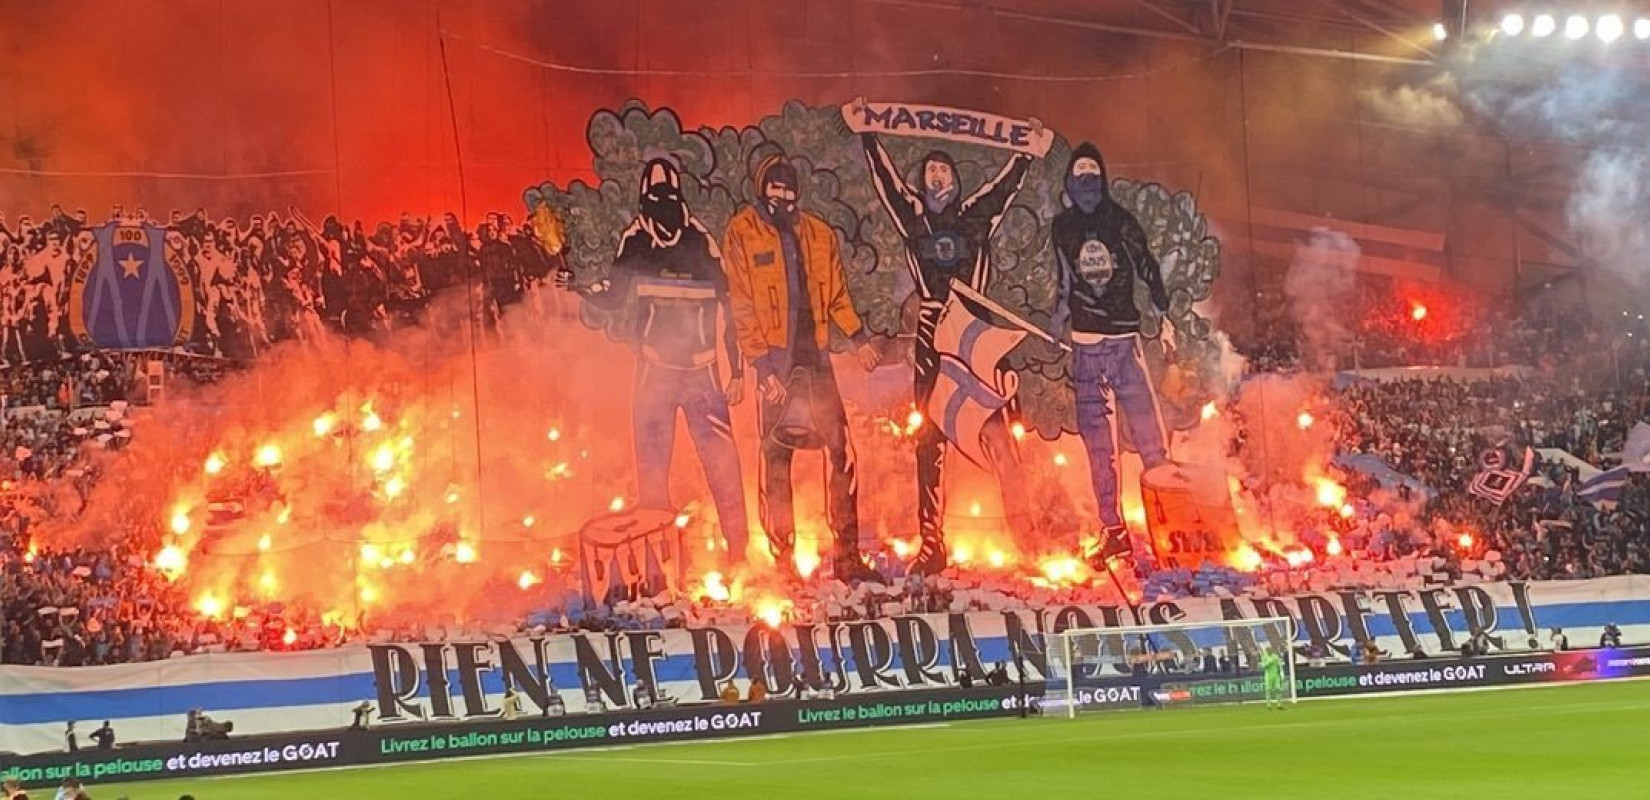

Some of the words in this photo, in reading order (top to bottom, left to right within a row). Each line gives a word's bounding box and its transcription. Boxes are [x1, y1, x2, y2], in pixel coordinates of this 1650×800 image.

[863, 106, 1033, 147] MARSEILLE
[119, 230, 142, 241] 100
[366, 634, 560, 722] RIEN
[570, 629, 680, 711] NE
[687, 610, 998, 701] POURRA
[998, 600, 1198, 682] NOUS
[1508, 581, 1539, 649] !
[1305, 673, 1357, 693] pelouse
[1359, 674, 1374, 687] et
[1375, 668, 1428, 685] devenez
[1429, 667, 1441, 681] le
[1442, 664, 1486, 681] GOAT
[798, 707, 841, 724] Livrez
[842, 706, 856, 721] le
[858, 701, 903, 720] ballon
[904, 702, 926, 717] sur
[928, 700, 941, 715] la
[943, 696, 999, 717] pelouse
[1001, 696, 1016, 710] et
[1093, 686, 1141, 702] GOAT
[381, 738, 429, 754] Livrez
[430, 735, 446, 750] le
[448, 732, 498, 750] ballon
[500, 731, 525, 745] sur
[527, 728, 542, 743] la
[543, 725, 606, 745] pelouse
[608, 723, 626, 738] et
[627, 719, 693, 736] devenez
[694, 717, 709, 731] le
[710, 711, 763, 730] GOAT
[45, 767, 72, 779] sur
[75, 761, 91, 777] la
[93, 758, 163, 779] pelouse
[166, 757, 186, 771] et
[188, 750, 262, 769] devenez
[263, 748, 280, 763] le
[282, 742, 340, 761] GOAT
